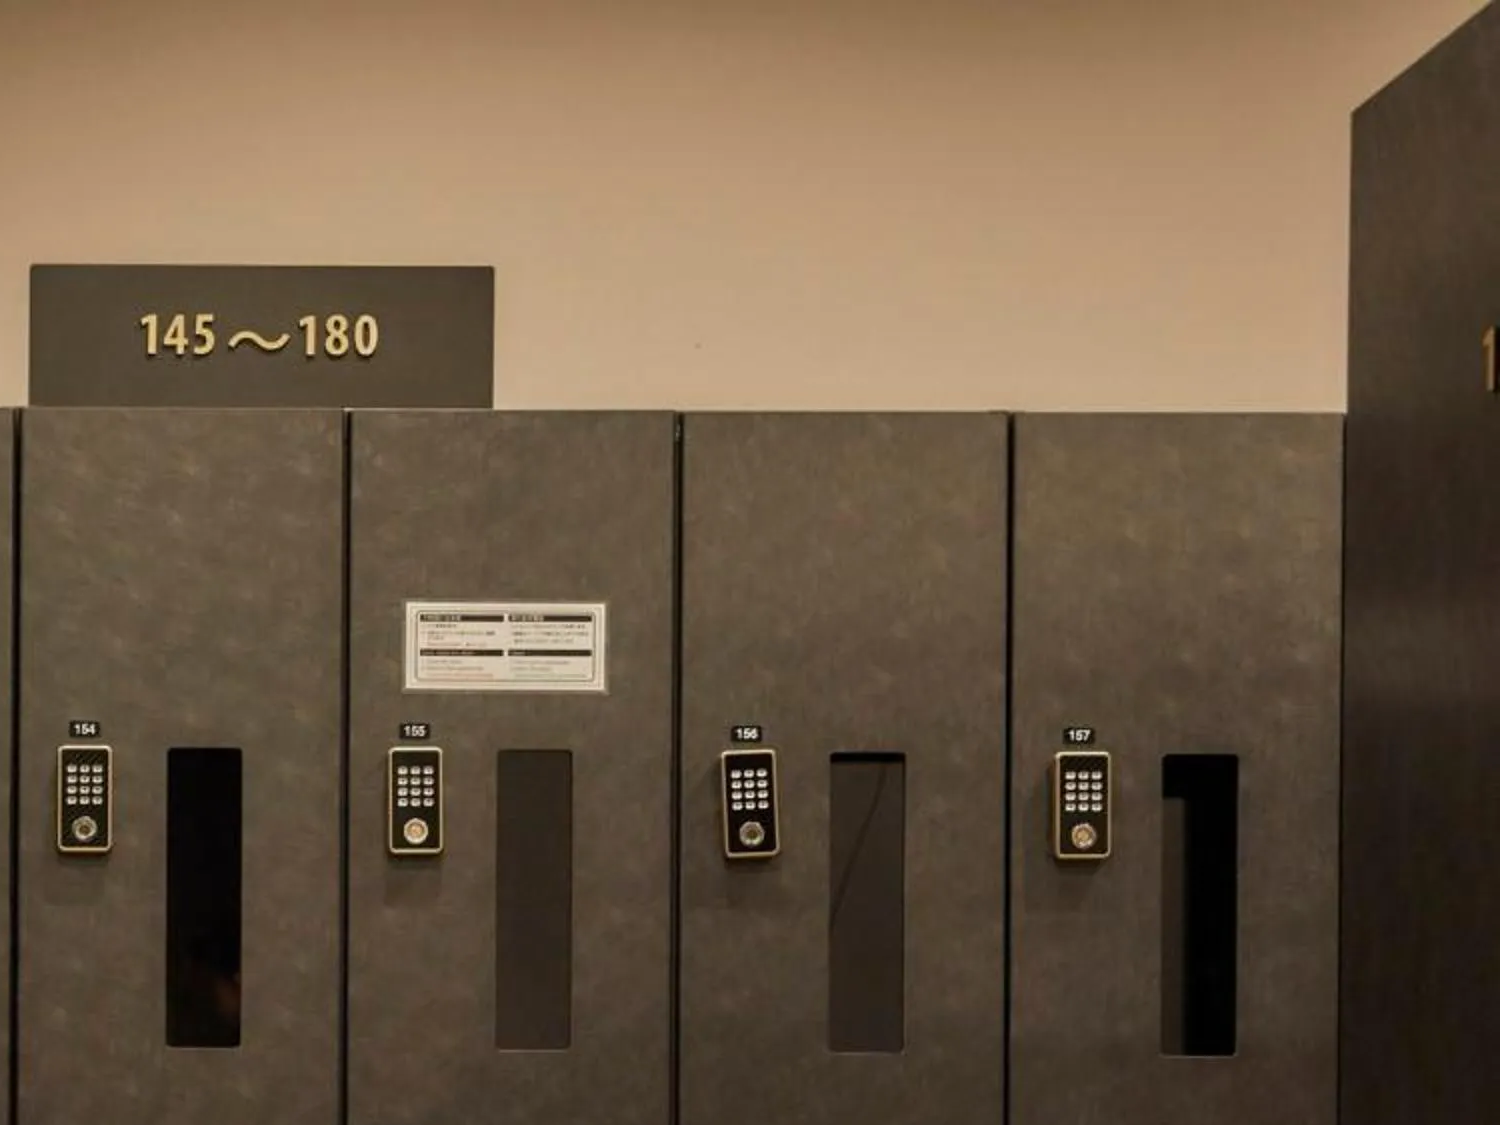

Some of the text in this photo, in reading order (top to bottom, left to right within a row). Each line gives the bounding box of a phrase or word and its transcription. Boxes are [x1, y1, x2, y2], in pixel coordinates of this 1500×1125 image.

[74, 723, 96, 735] 154
[404, 725, 426, 737] 155
[736, 727, 759, 740] 156
[1069, 729, 1091, 741] 157
